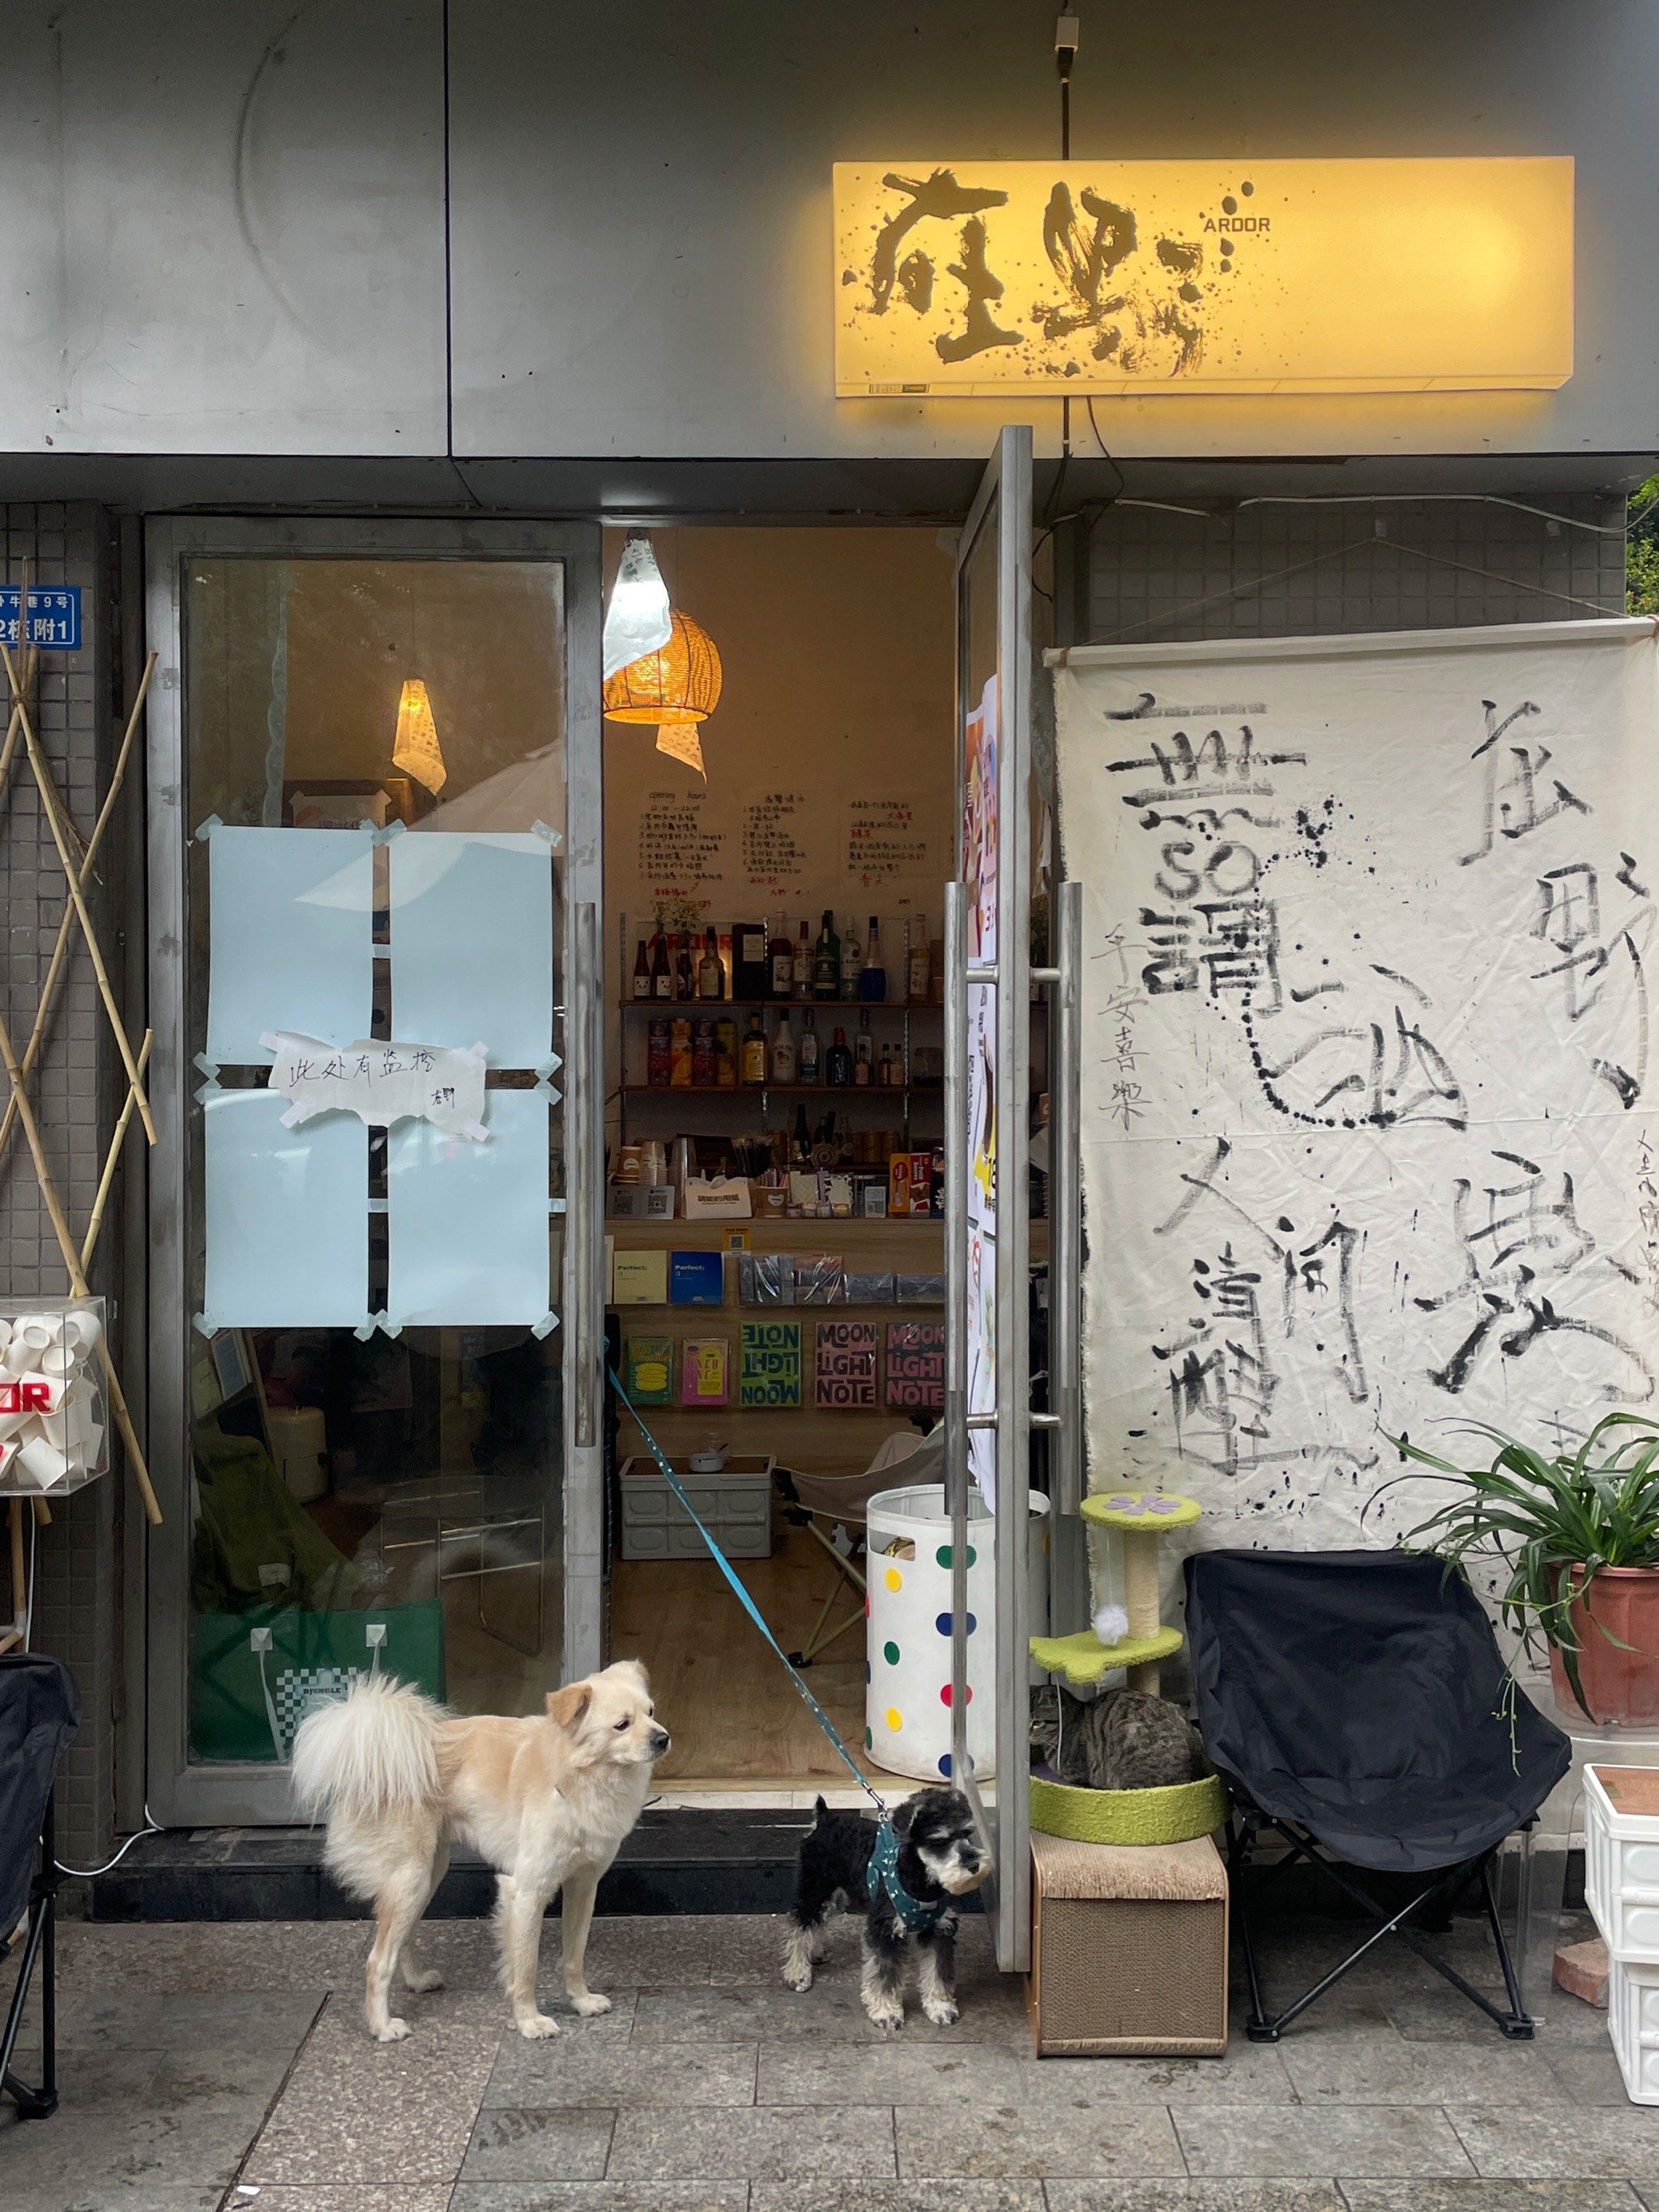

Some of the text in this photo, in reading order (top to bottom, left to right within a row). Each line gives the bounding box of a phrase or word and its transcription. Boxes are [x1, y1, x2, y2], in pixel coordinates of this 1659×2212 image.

[1203, 217, 1271, 233] ARDOR
[289, 1048, 436, 1087] 此处有监控
[742, 1324, 800, 1349] NOTE
[817, 1324, 876, 1347] MOON
[741, 1379, 800, 1404] MOON
[817, 1379, 876, 1403] NOTE
[886, 1381, 945, 1406] NOTE
